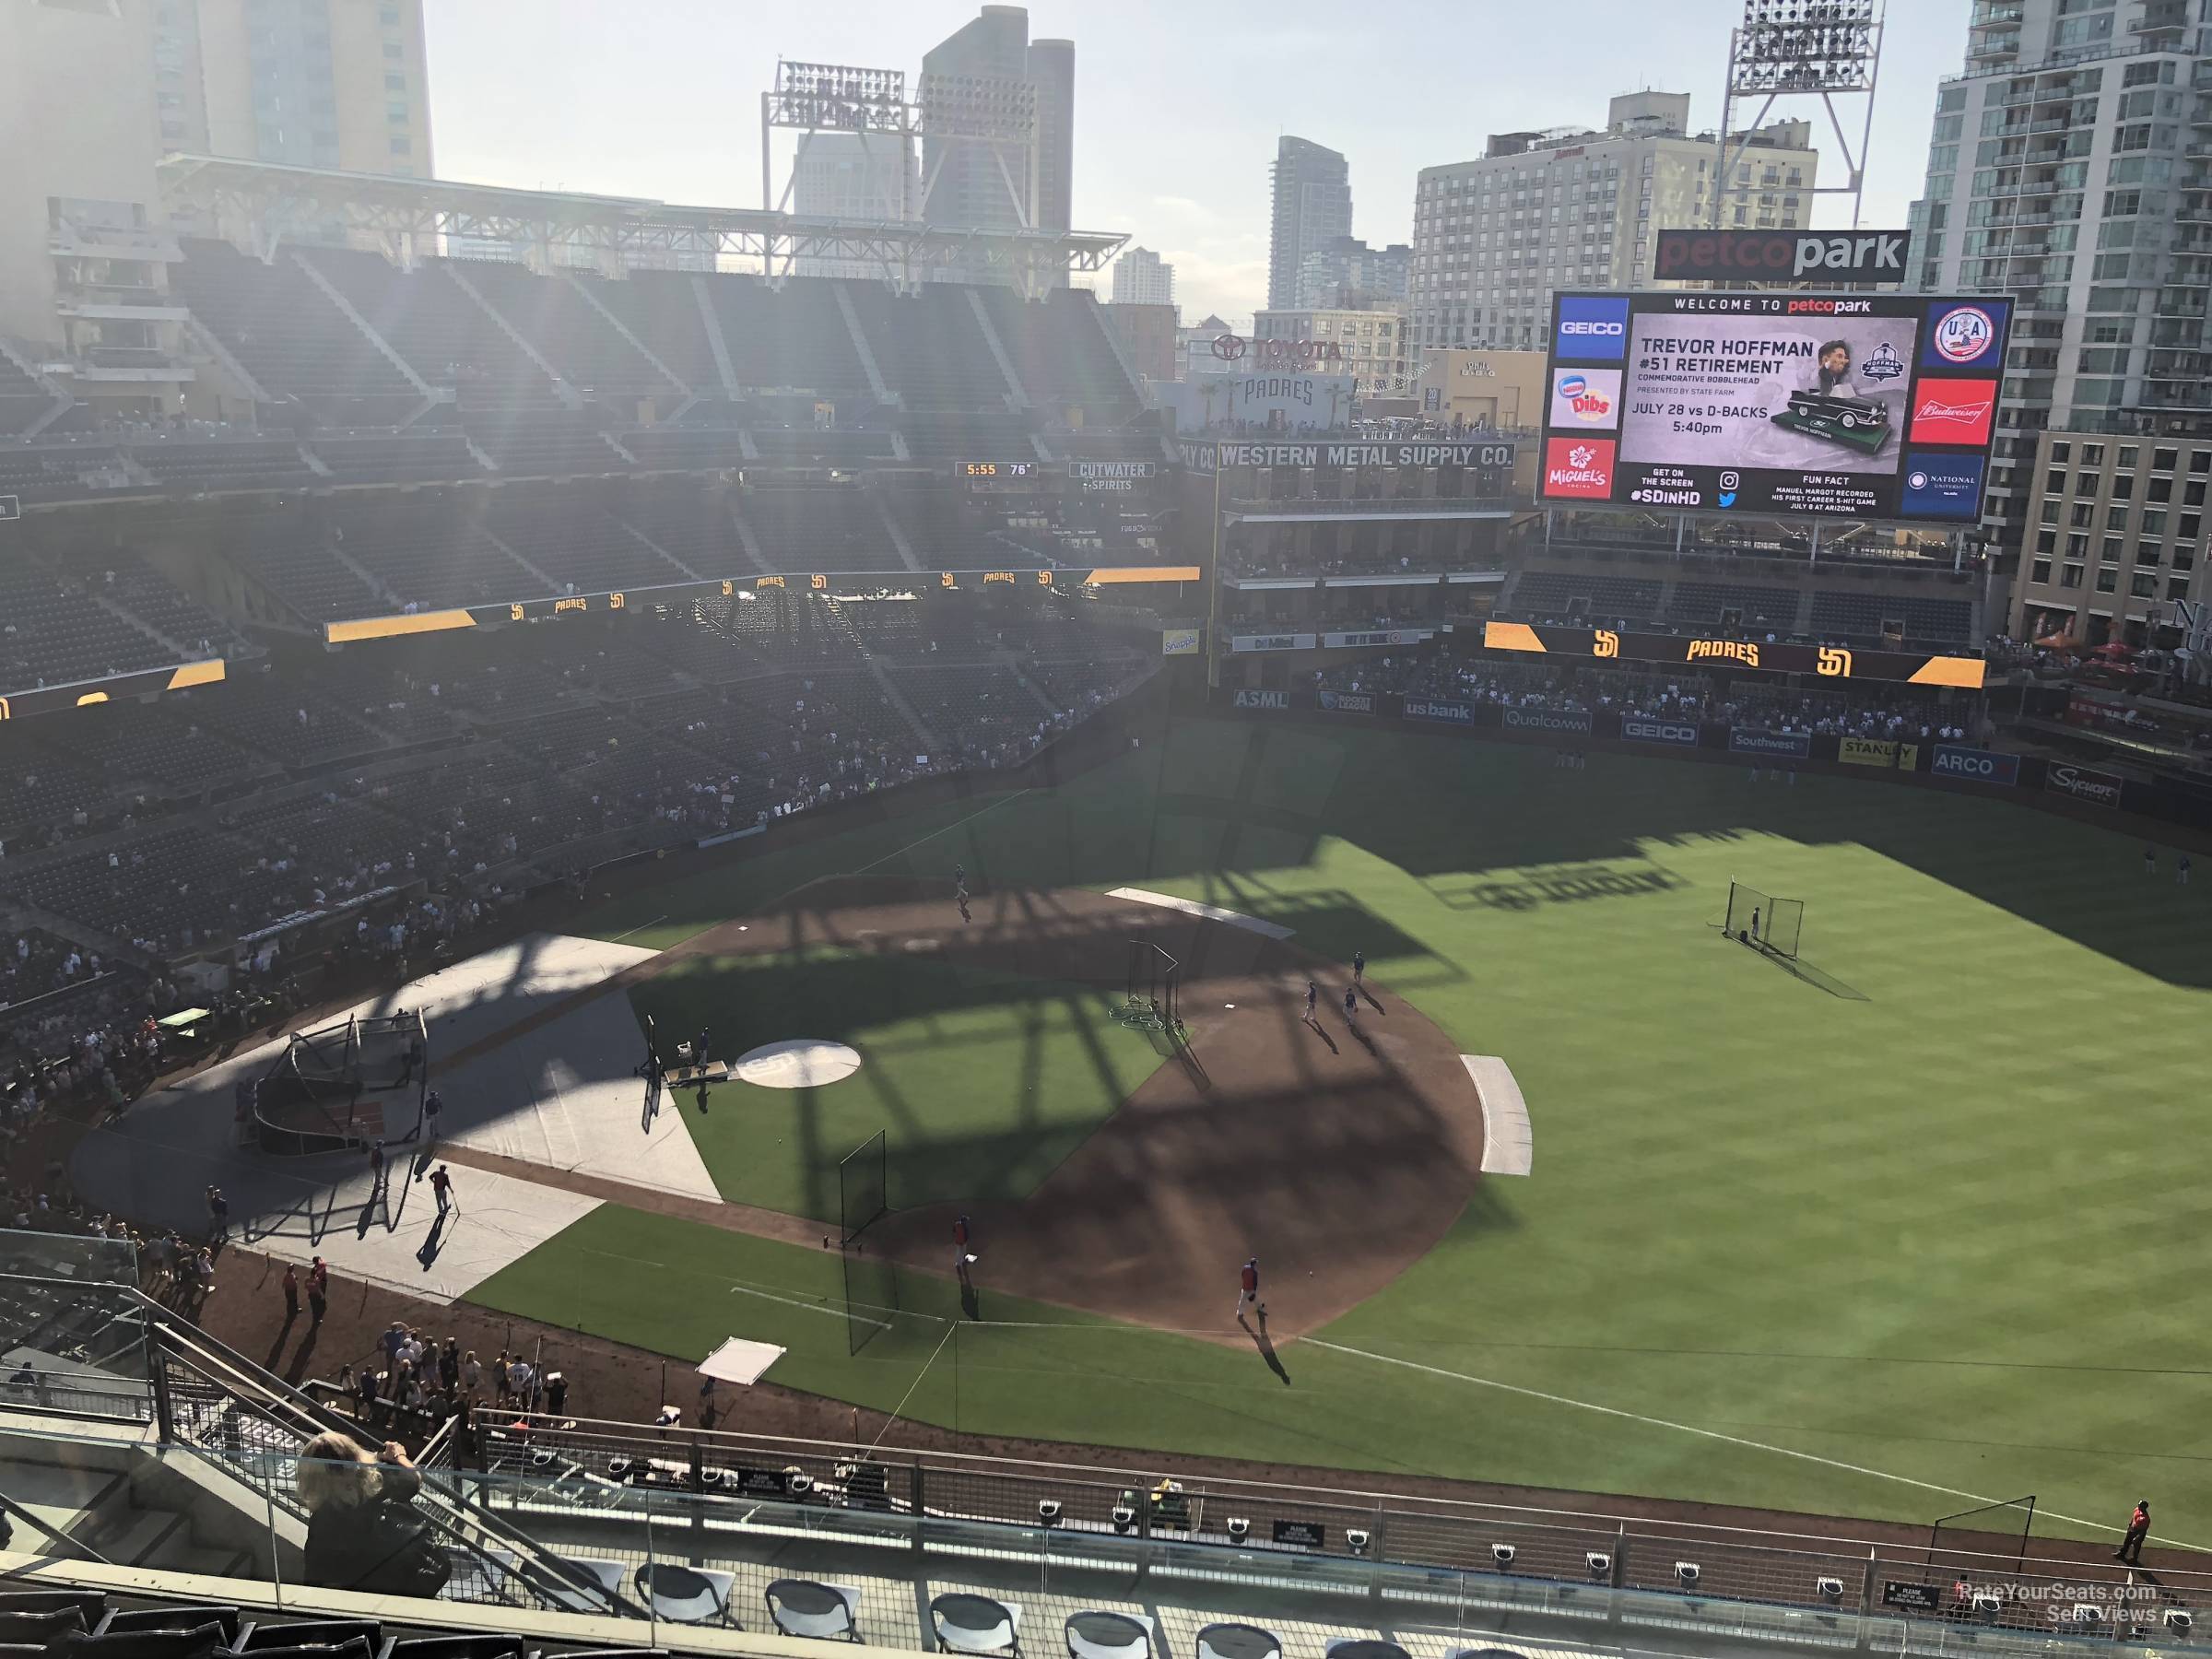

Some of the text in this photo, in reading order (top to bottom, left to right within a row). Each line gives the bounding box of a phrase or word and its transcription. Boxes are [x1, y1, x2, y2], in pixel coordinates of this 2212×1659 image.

[1675, 298, 1752, 311] WELCOME
[1761, 300, 1780, 311] TO
[1560, 322, 1622, 335] GEICO
[1256, 339, 1342, 360] TOYOTA
[1641, 338, 1813, 357] TREVOR HOFFMAN
[1640, 358, 1783, 374] #51 RETIREMENT
[1638, 373, 1759, 384] COMMEMORATIVE BOBBLEHEAD
[1245, 378, 1312, 406] PADRES
[1637, 386, 1678, 395] PRESENTED
[1691, 388, 1712, 396] STATE
[1571, 394, 1609, 414] Dibs
[1632, 403, 1768, 418] JULY 28 vs D-BACKS
[1923, 406, 1981, 417] Budweiser
[1673, 421, 1723, 434] 5:40pm
[1221, 446, 1512, 466] WESTERN METAL SUPPLY CO.
[967, 464, 996, 476] 5:55
[1079, 464, 1146, 477] CUTWATER
[1653, 468, 1684, 477] GET ON
[1091, 479, 1132, 490] SPIRITS
[1641, 477, 1693, 488] THE SCREEN
[1803, 475, 1849, 486] FUN FACT
[1776, 487, 1803, 495] MANUEL
[1836, 489, 1874, 498] RECORDED
[757, 575, 785, 590] PADRES
[983, 571, 1015, 584] PADRES
[555, 596, 587, 614] PADRES
[1165, 635, 1196, 653] Snapple
[1686, 640, 1759, 667] PADRES
[1235, 690, 1288, 709] ASML
[1625, 722, 1696, 741] GEICO
[1735, 735, 1794, 751] Southwest
[1845, 741, 1912, 759] STANLY
[1936, 752, 1994, 775] ARCO
[2048, 768, 2121, 798] Sycuan
